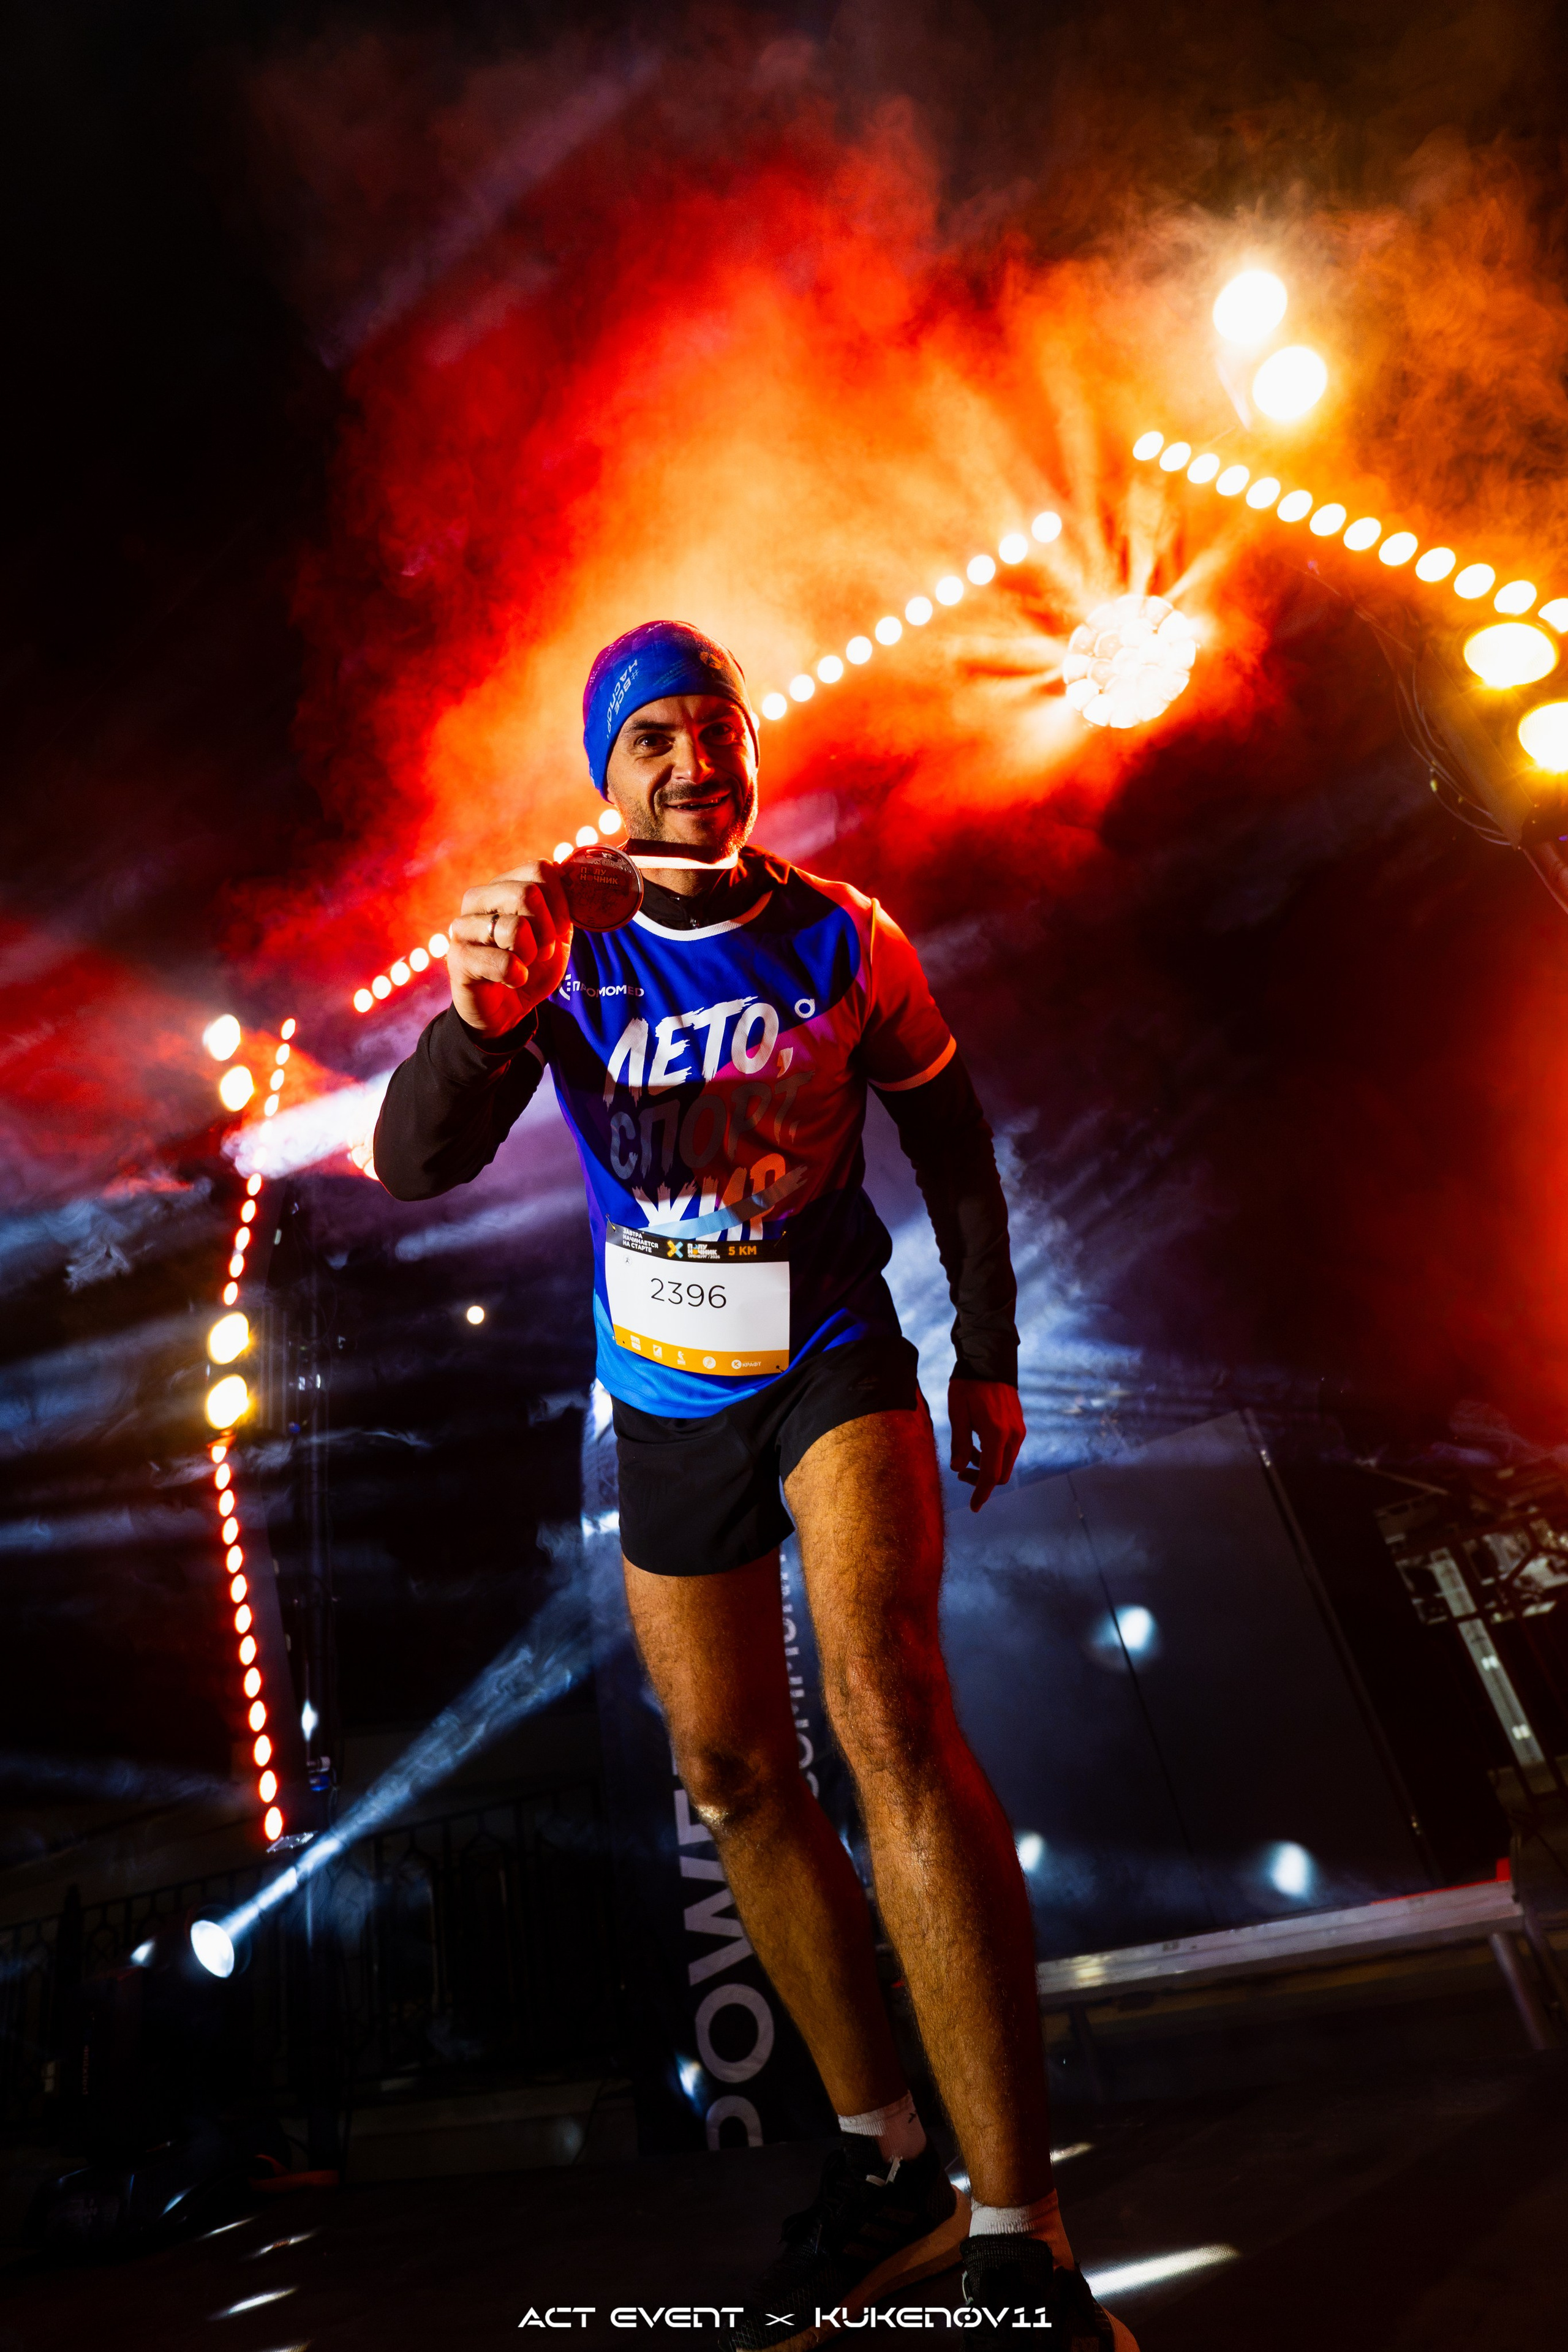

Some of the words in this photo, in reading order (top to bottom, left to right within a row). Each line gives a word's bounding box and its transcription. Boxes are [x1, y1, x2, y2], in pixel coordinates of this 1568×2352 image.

[581, 867, 606, 875] ПЛУ
[603, 996, 793, 1112] ЛЕТО,
[623, 1228, 643, 1238] ЗАВТРА
[623, 1234, 659, 1249] НАЧИНАЕТСЯ
[631, 1243, 652, 1253] СТАРТЕ
[728, 1246, 736, 1256] 5
[651, 1278, 726, 1308] 2396
[671, 1740, 775, 2151] POW
